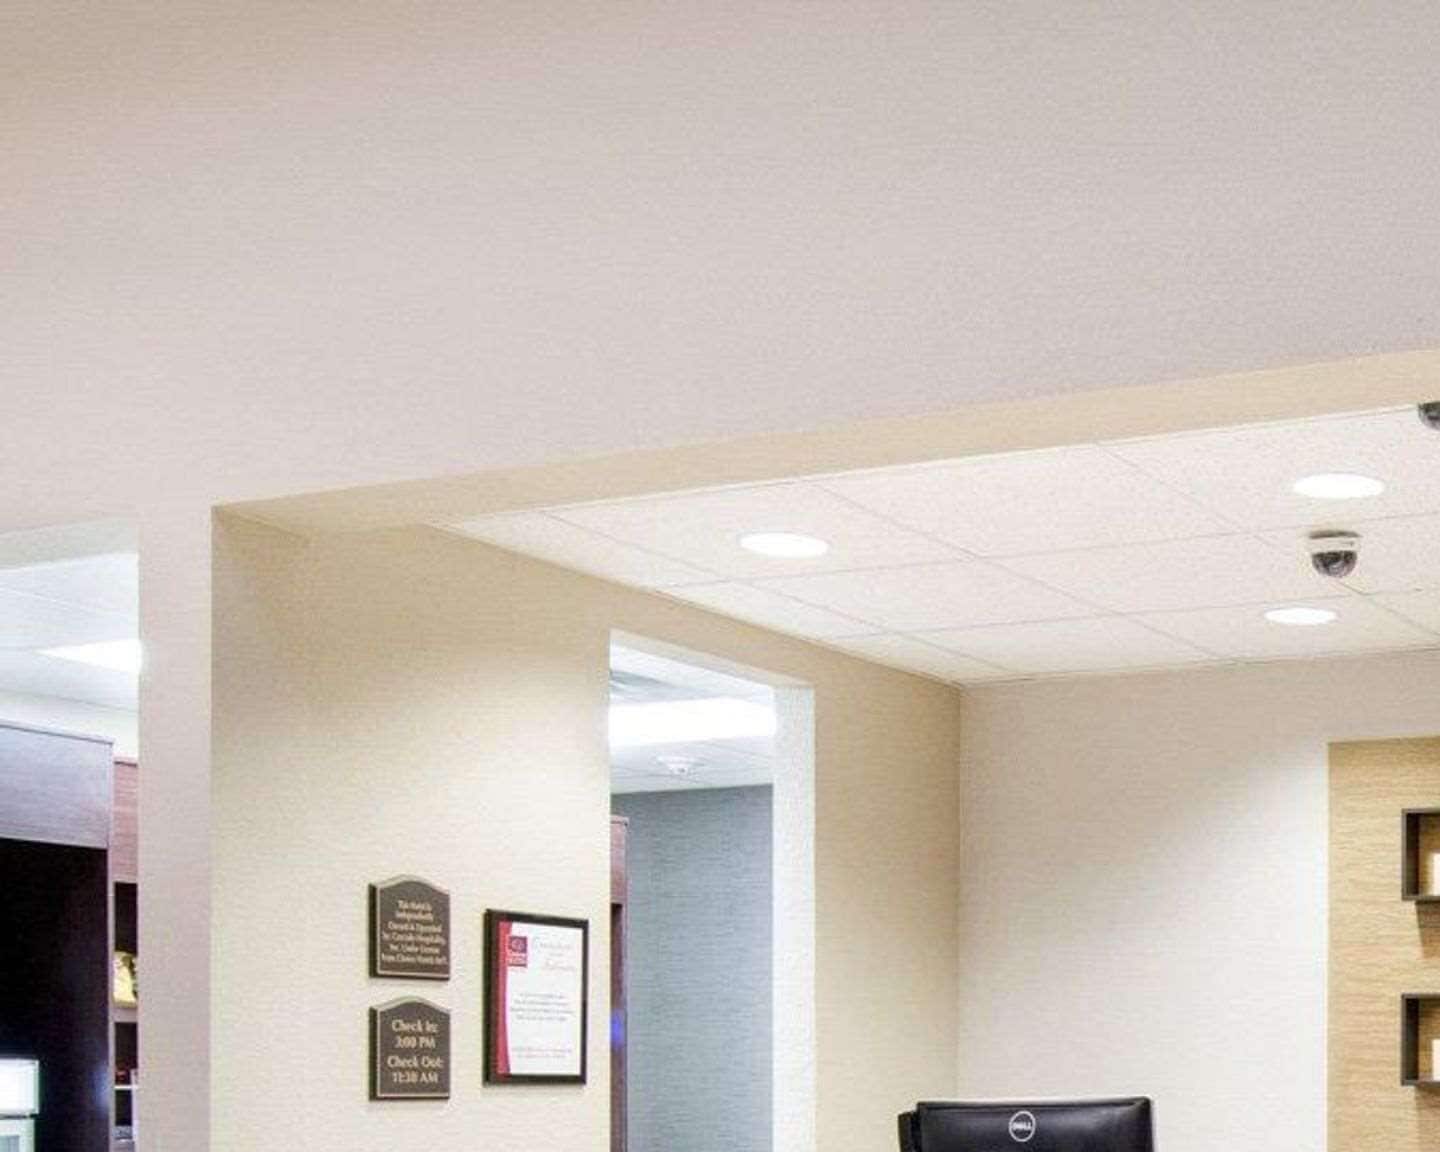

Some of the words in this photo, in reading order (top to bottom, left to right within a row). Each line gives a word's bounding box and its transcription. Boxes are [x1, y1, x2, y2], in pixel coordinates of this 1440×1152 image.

[391, 1019, 423, 1033] Check
[419, 1036, 436, 1049] PM
[387, 1055, 418, 1069] Check
[420, 1071, 439, 1085] AM
